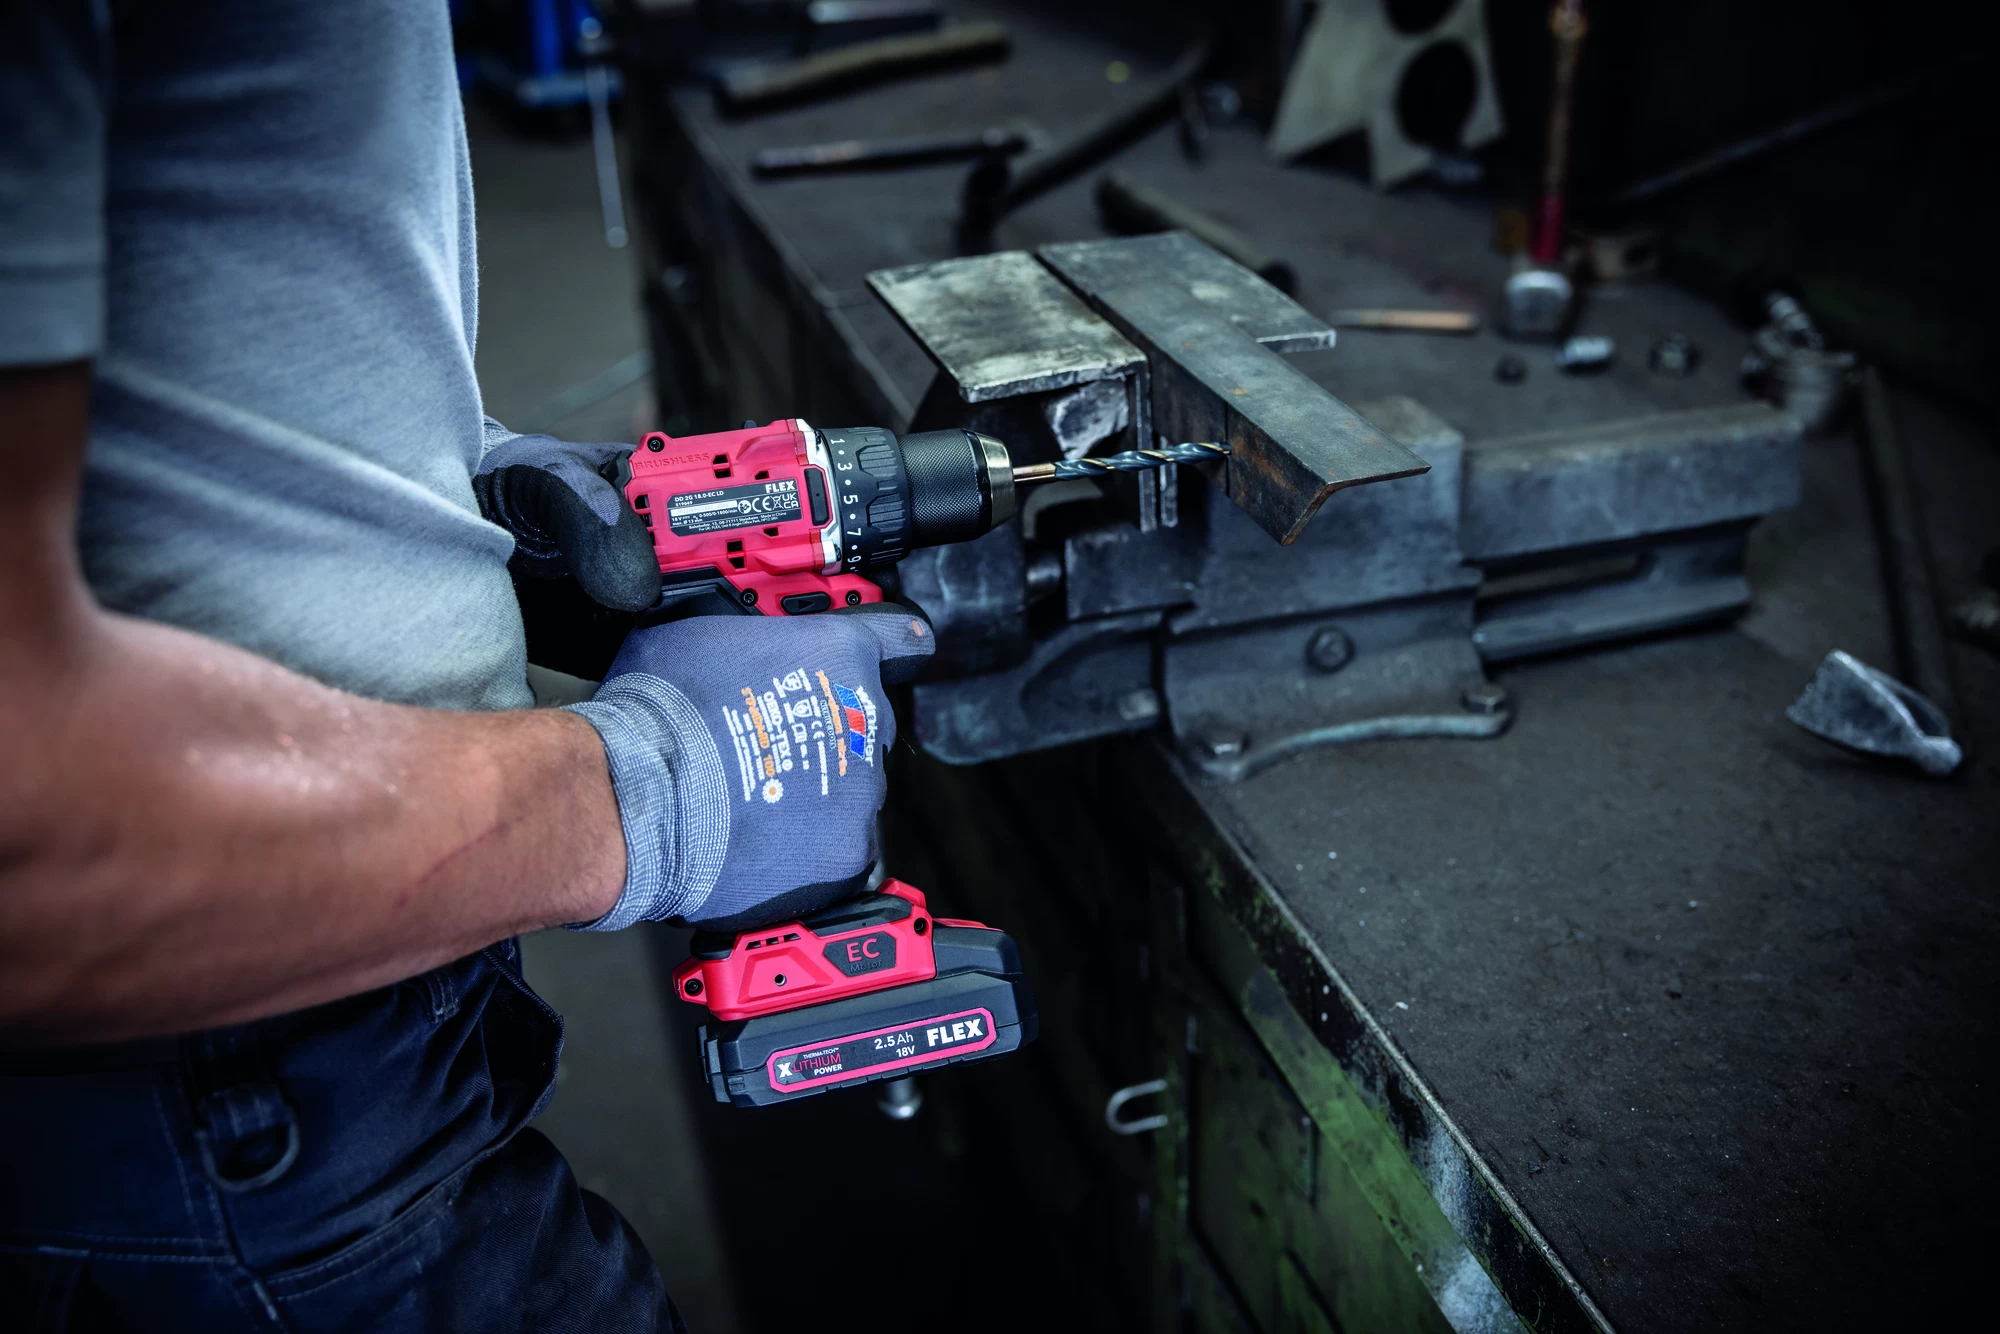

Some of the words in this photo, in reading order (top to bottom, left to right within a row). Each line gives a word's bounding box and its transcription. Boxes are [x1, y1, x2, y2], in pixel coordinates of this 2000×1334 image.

[634, 453, 710, 470] BRUSHLESS
[838, 462, 852, 471] 3
[765, 480, 795, 493] FLEX
[782, 492, 797, 501] UK
[844, 495, 858, 505] 5
[784, 501, 798, 509] CA
[847, 528, 861, 537] 7
[848, 555, 861, 563] 9
[741, 687, 770, 749] STANDARD
[763, 754, 775, 776] 100
[846, 938, 880, 962] EC
[850, 961, 882, 973] Motor
[926, 1018, 983, 1047] FLEX
[896, 1046, 915, 1057] 18V
[777, 1062, 793, 1077] X
[793, 1053, 842, 1073] LITHIUM
[814, 1064, 843, 1076] POWER
